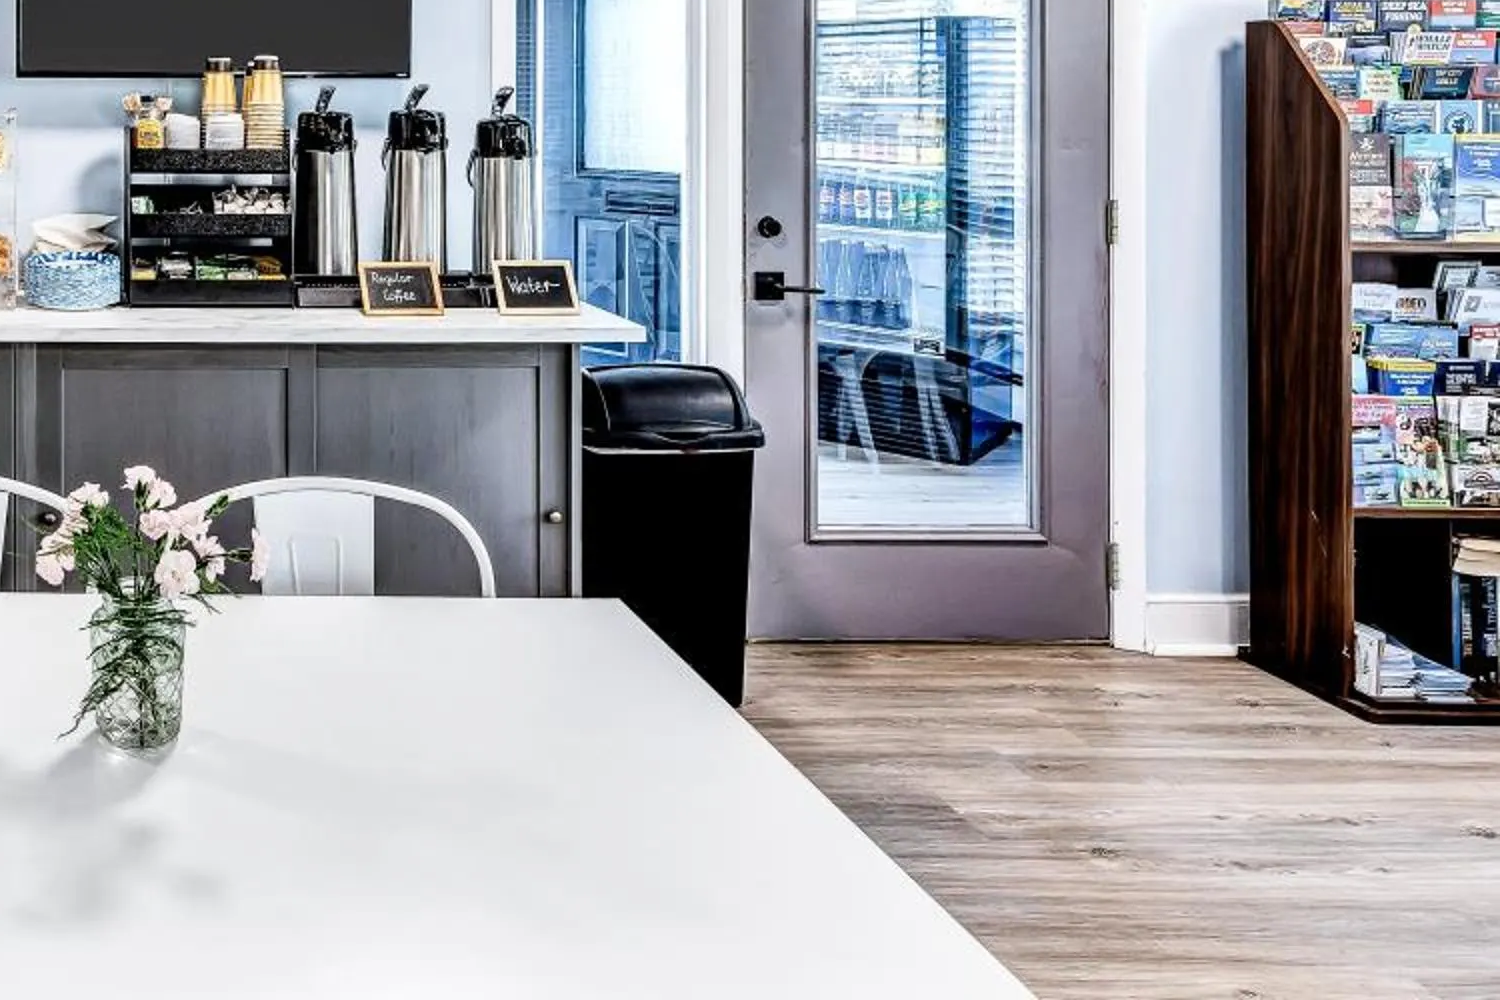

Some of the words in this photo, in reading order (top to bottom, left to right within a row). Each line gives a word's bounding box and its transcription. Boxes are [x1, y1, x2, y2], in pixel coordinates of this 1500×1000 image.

[371, 271, 415, 287] Regular
[505, 274, 560, 295] Water
[382, 288, 417, 304] Coffee
